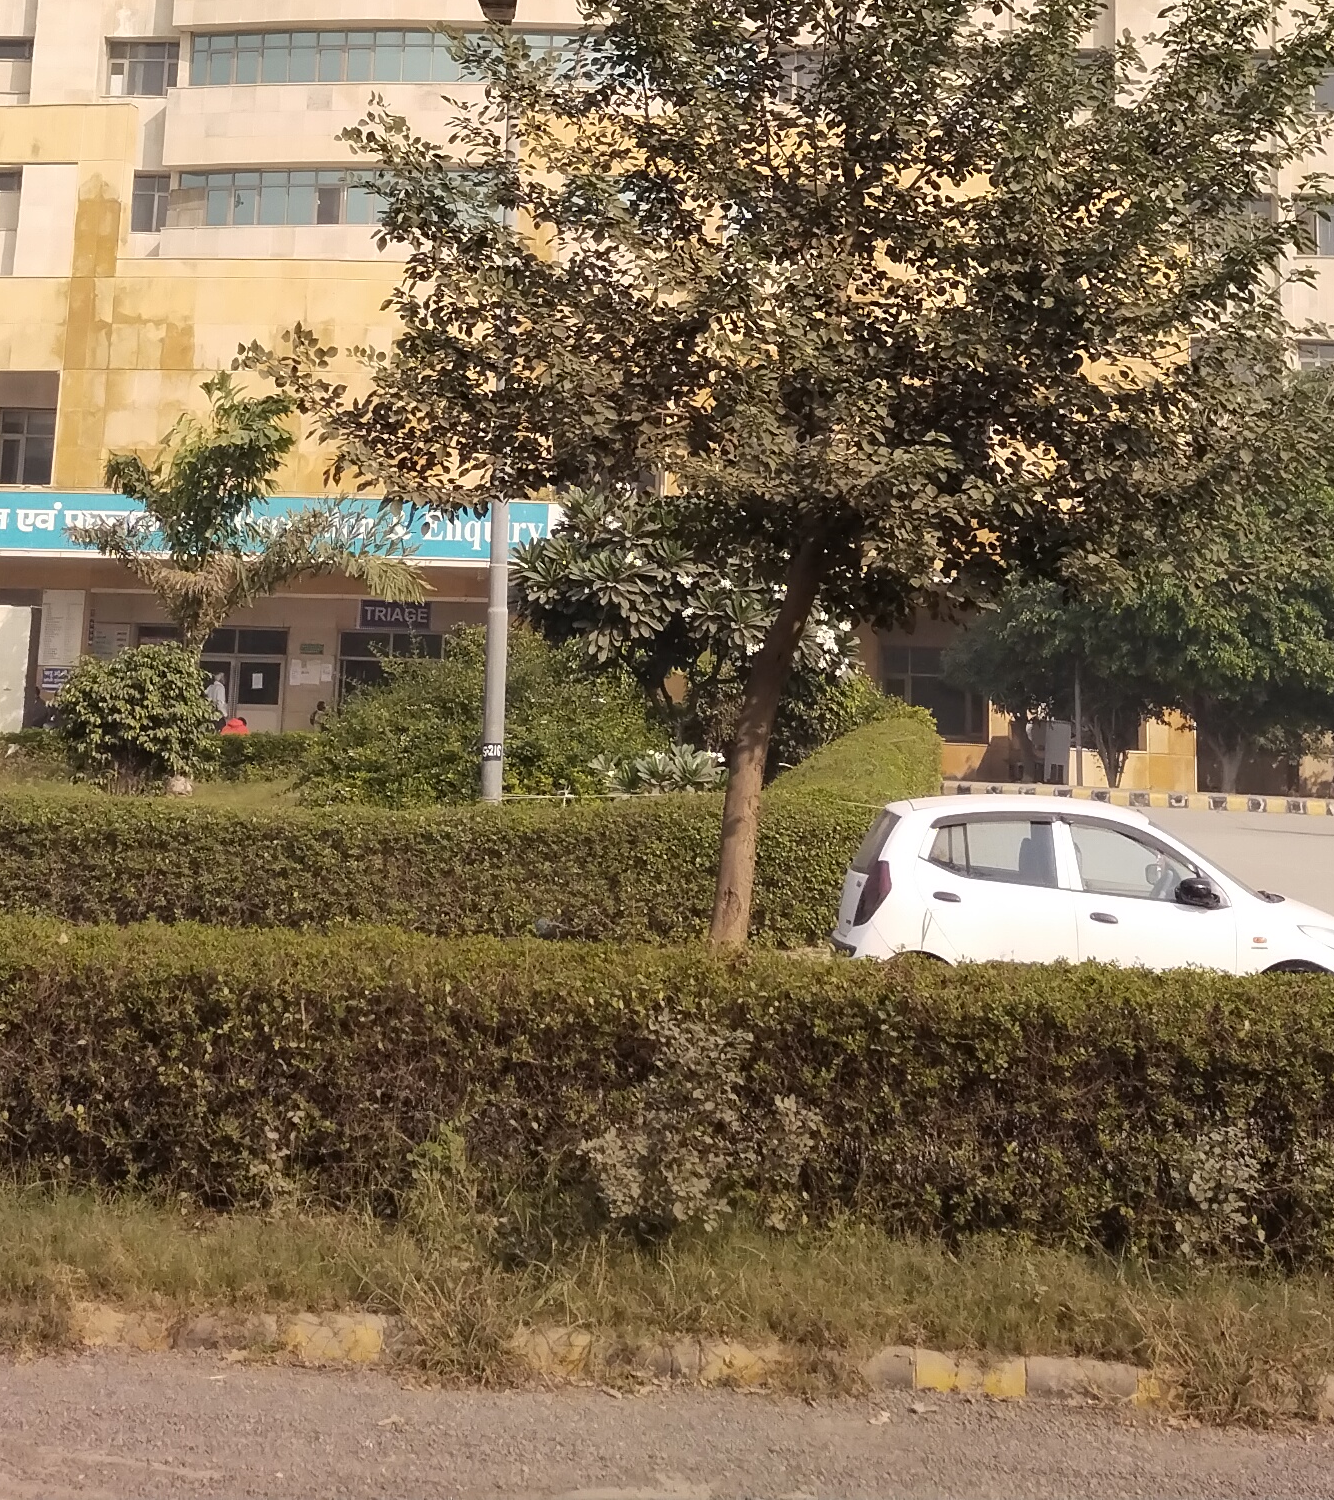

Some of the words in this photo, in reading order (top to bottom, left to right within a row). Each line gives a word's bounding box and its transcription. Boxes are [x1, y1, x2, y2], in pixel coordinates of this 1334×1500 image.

[16, 501, 63, 532] एवं
[422, 511, 544, 551] Enqiry
[364, 606, 428, 623] TRIAGE
